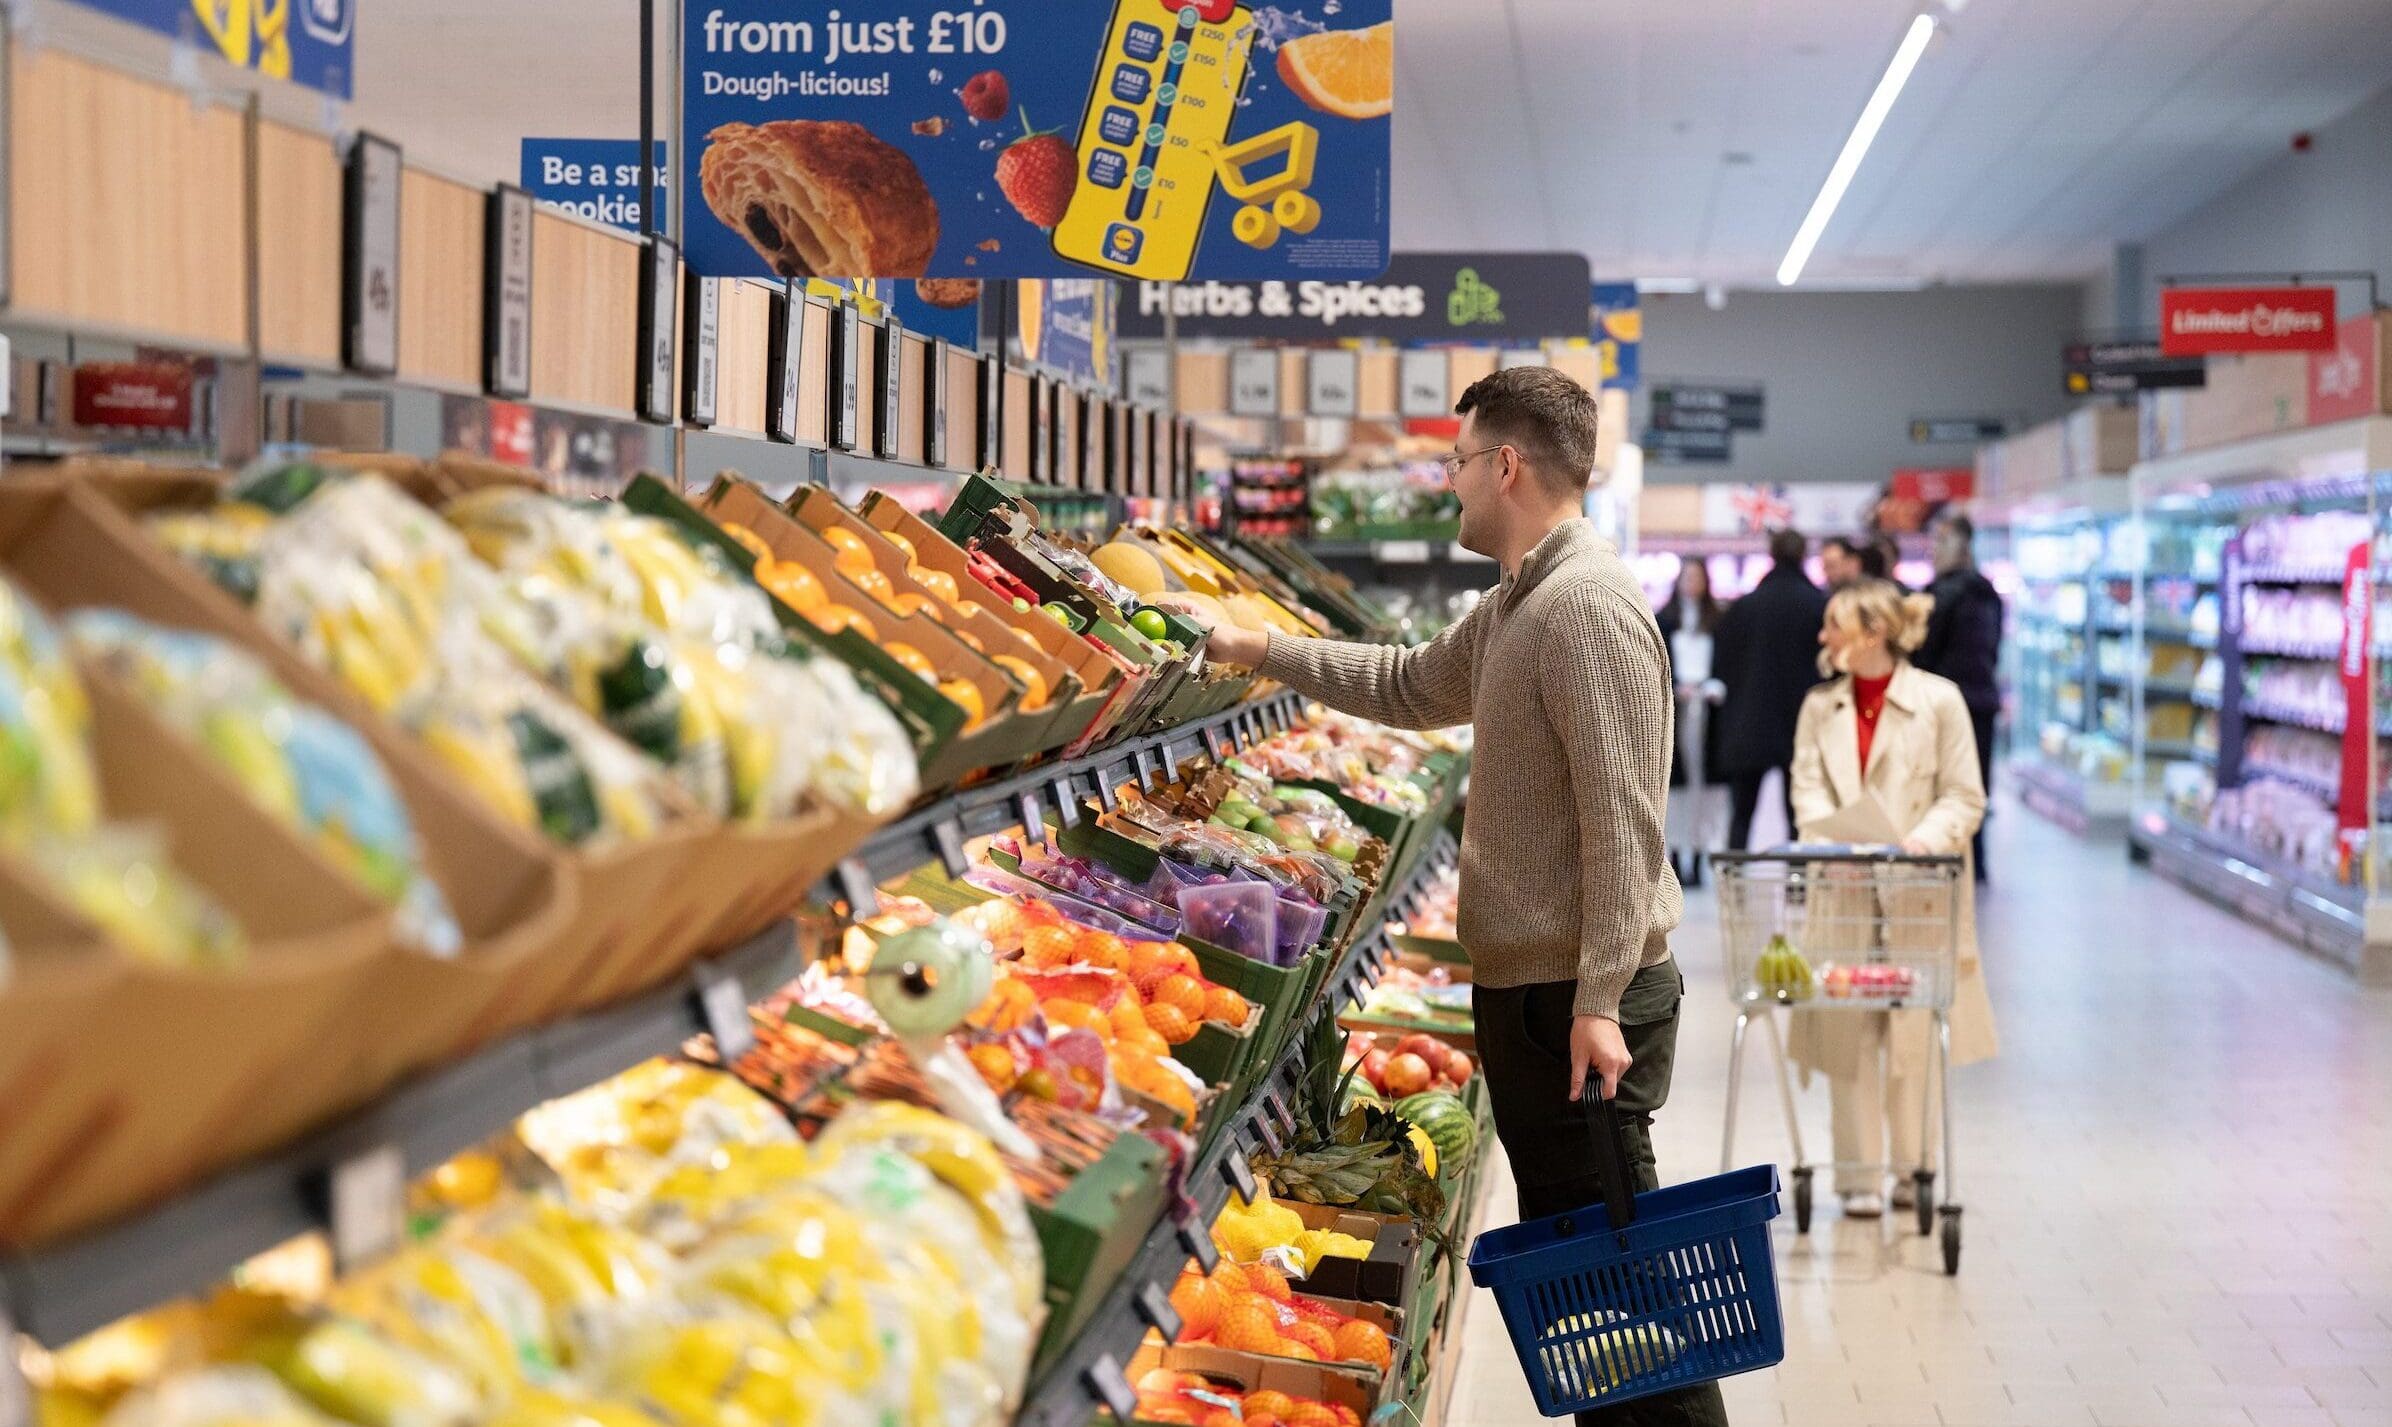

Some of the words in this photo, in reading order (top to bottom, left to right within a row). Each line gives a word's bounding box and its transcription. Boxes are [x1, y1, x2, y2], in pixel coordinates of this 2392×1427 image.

[703, 9, 813, 53] from
[823, 9, 915, 65] just
[926, 10, 1007, 54] £10
[1129, 27, 1157, 44] FREE
[1201, 27, 1225, 41] £250
[1193, 52, 1217, 66] £150
[1117, 69, 1145, 85] FREE
[702, 70, 890, 101] Dough-licious!
[1181, 94, 1206, 109] £100
[1106, 112, 1134, 128] FREE
[1170, 135, 1189, 148] £50
[1094, 151, 1122, 167] FREE
[541, 156, 583, 186] Be
[589, 163, 609, 186] a
[1158, 178, 1176, 190] £10
[1138, 280, 1254, 318] Herbs
[1258, 280, 1293, 318] &
[1297, 280, 1427, 326] Spices
